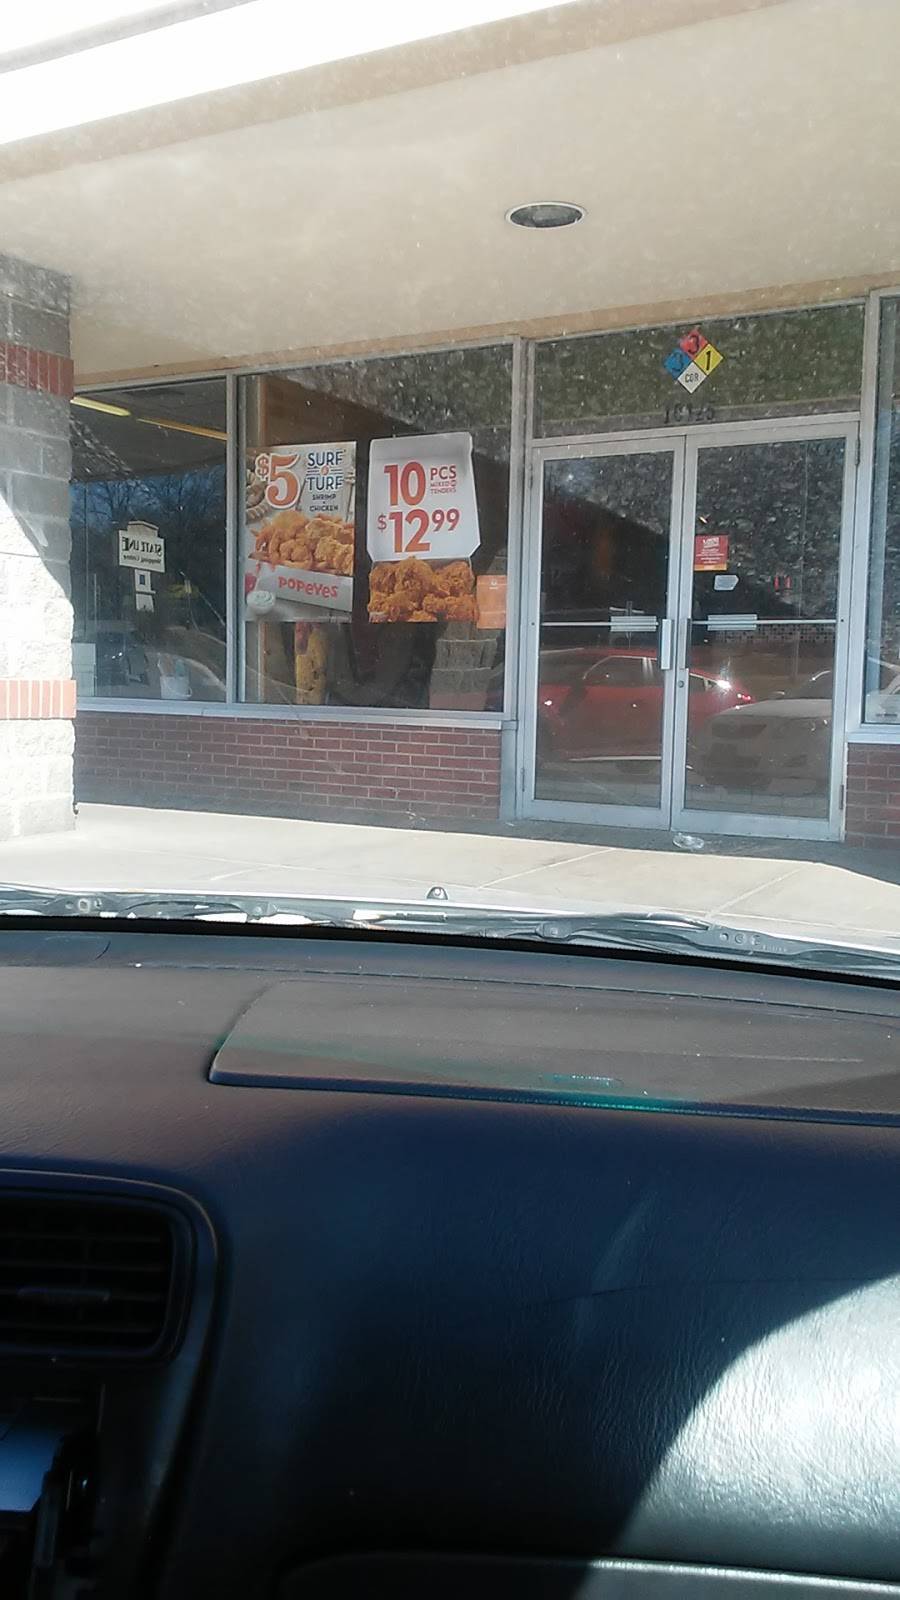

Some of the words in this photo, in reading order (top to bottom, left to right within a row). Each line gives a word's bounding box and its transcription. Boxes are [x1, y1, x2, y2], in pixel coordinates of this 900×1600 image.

[687, 334, 700, 354] 3
[705, 350, 712, 371] 1
[308, 451, 343, 466] SURF
[257, 454, 298, 508] $5
[307, 476, 343, 490] TURF
[384, 461, 426, 506] 10
[430, 466, 457, 480] PCS
[312, 493, 337, 501] SHRIMP
